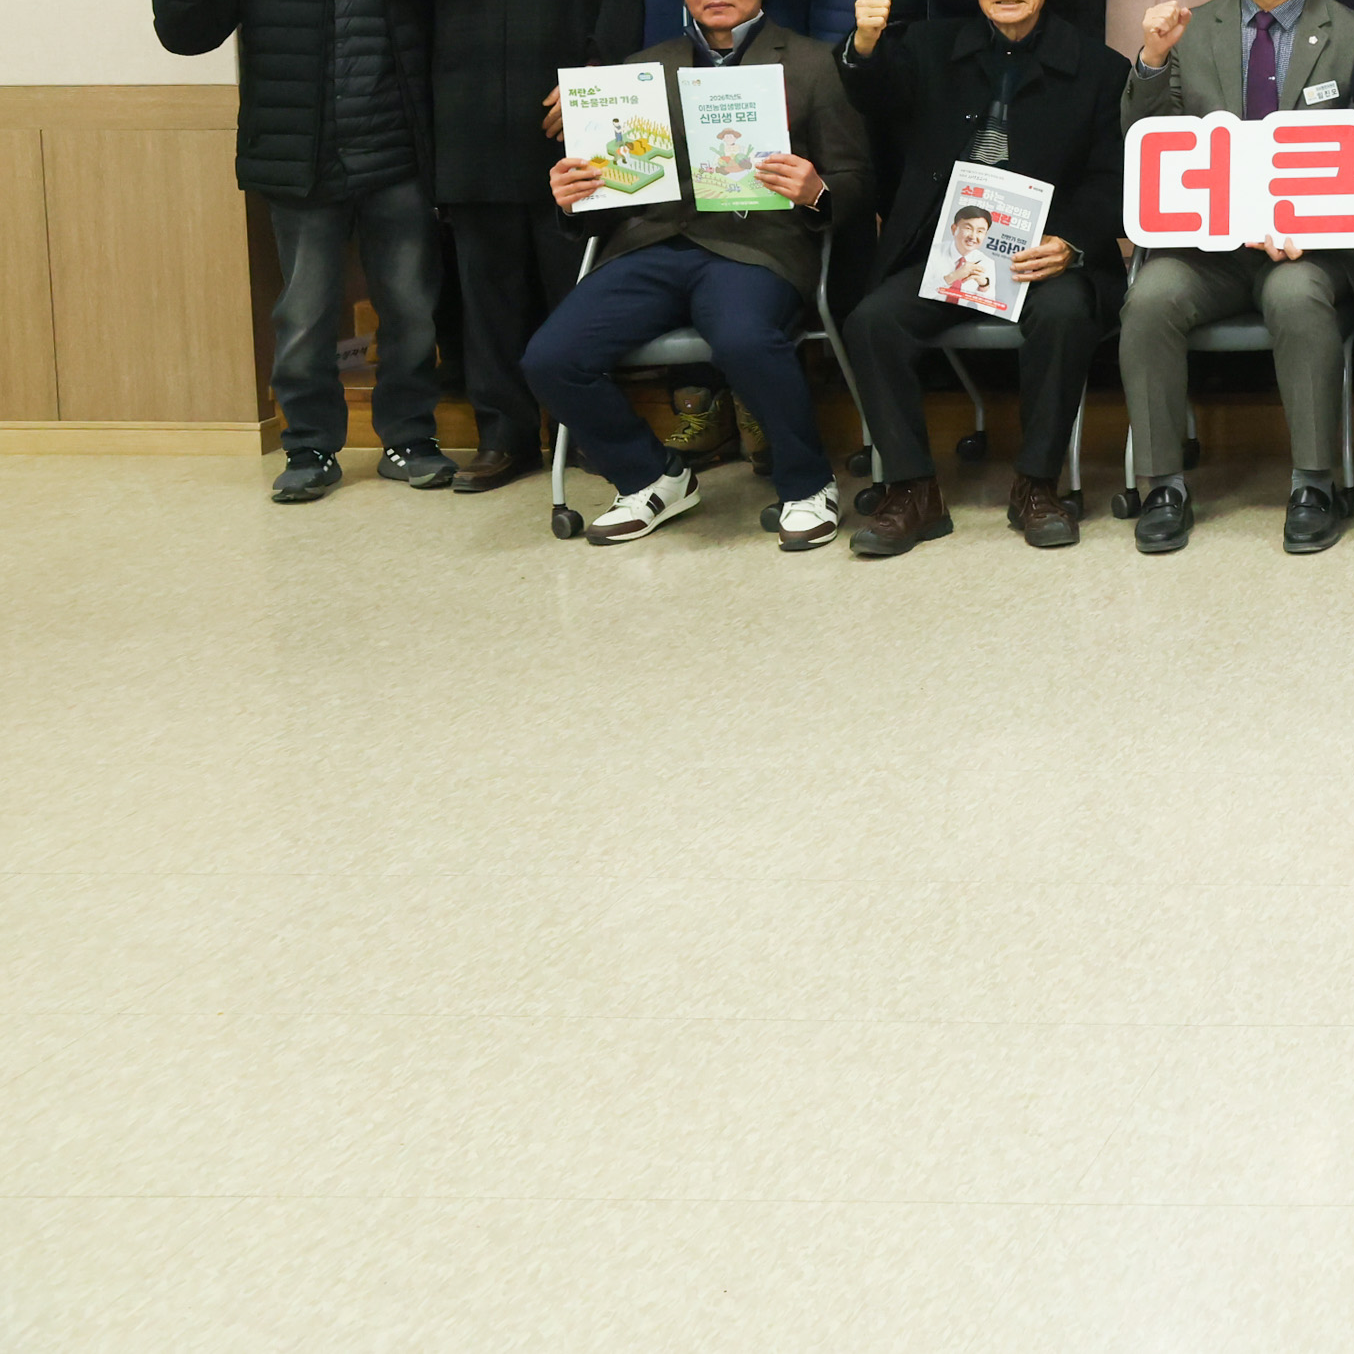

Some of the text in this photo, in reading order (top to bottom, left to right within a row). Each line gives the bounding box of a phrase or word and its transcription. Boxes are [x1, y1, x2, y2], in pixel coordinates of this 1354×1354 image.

[568, 87, 597, 98] 저탄소
[569, 99, 579, 108] 벼
[621, 95, 639, 105] 기술
[700, 111, 757, 124] 신입생 모집
[1139, 126, 1231, 236] 더
